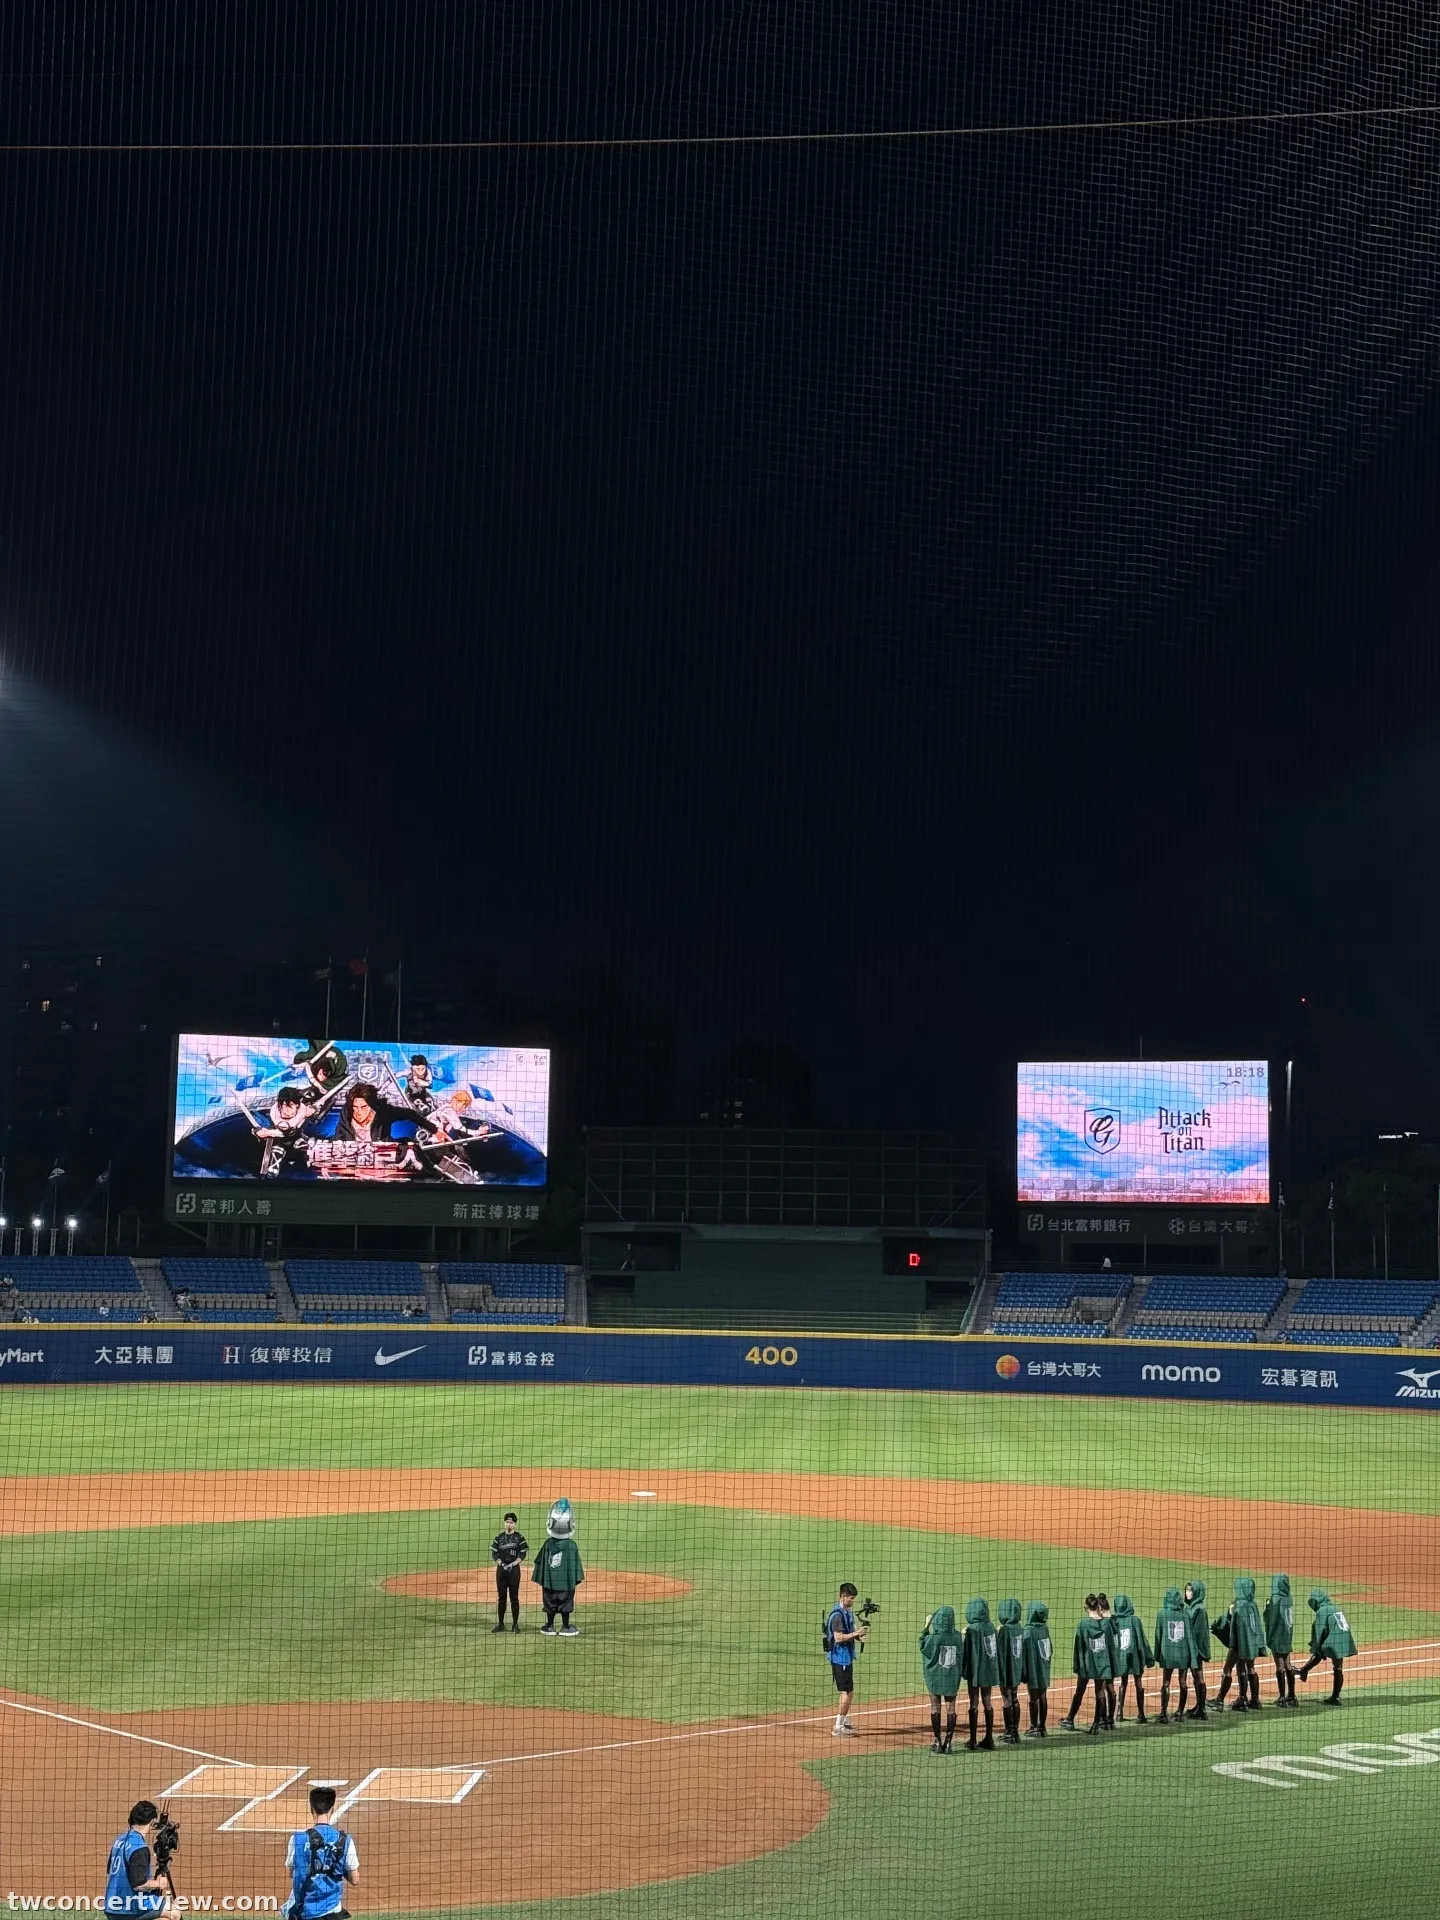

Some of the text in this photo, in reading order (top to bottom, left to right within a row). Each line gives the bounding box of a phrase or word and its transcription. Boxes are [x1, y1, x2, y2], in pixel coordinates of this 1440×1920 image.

[1226, 1067, 1265, 1078] 18:18
[1157, 1106, 1212, 1129] Attack
[1178, 1126, 1192, 1137] on
[1160, 1131, 1207, 1154] Titan
[201, 1198, 271, 1216] 富邦人壽
[453, 1203, 540, 1221] 新莊棒球場
[1047, 1218, 1131, 1233] 台北富邦銀行
[94, 1346, 174, 1364] 大亞集團
[250, 1347, 333, 1364] 復華投信
[491, 1351, 555, 1366] 富邦金控
[745, 1346, 798, 1366] 400
[1027, 1361, 1102, 1378] 台灣大哥大
[1141, 1364, 1221, 1383] momo
[1261, 1368, 1339, 1388] 宏碁資訊
